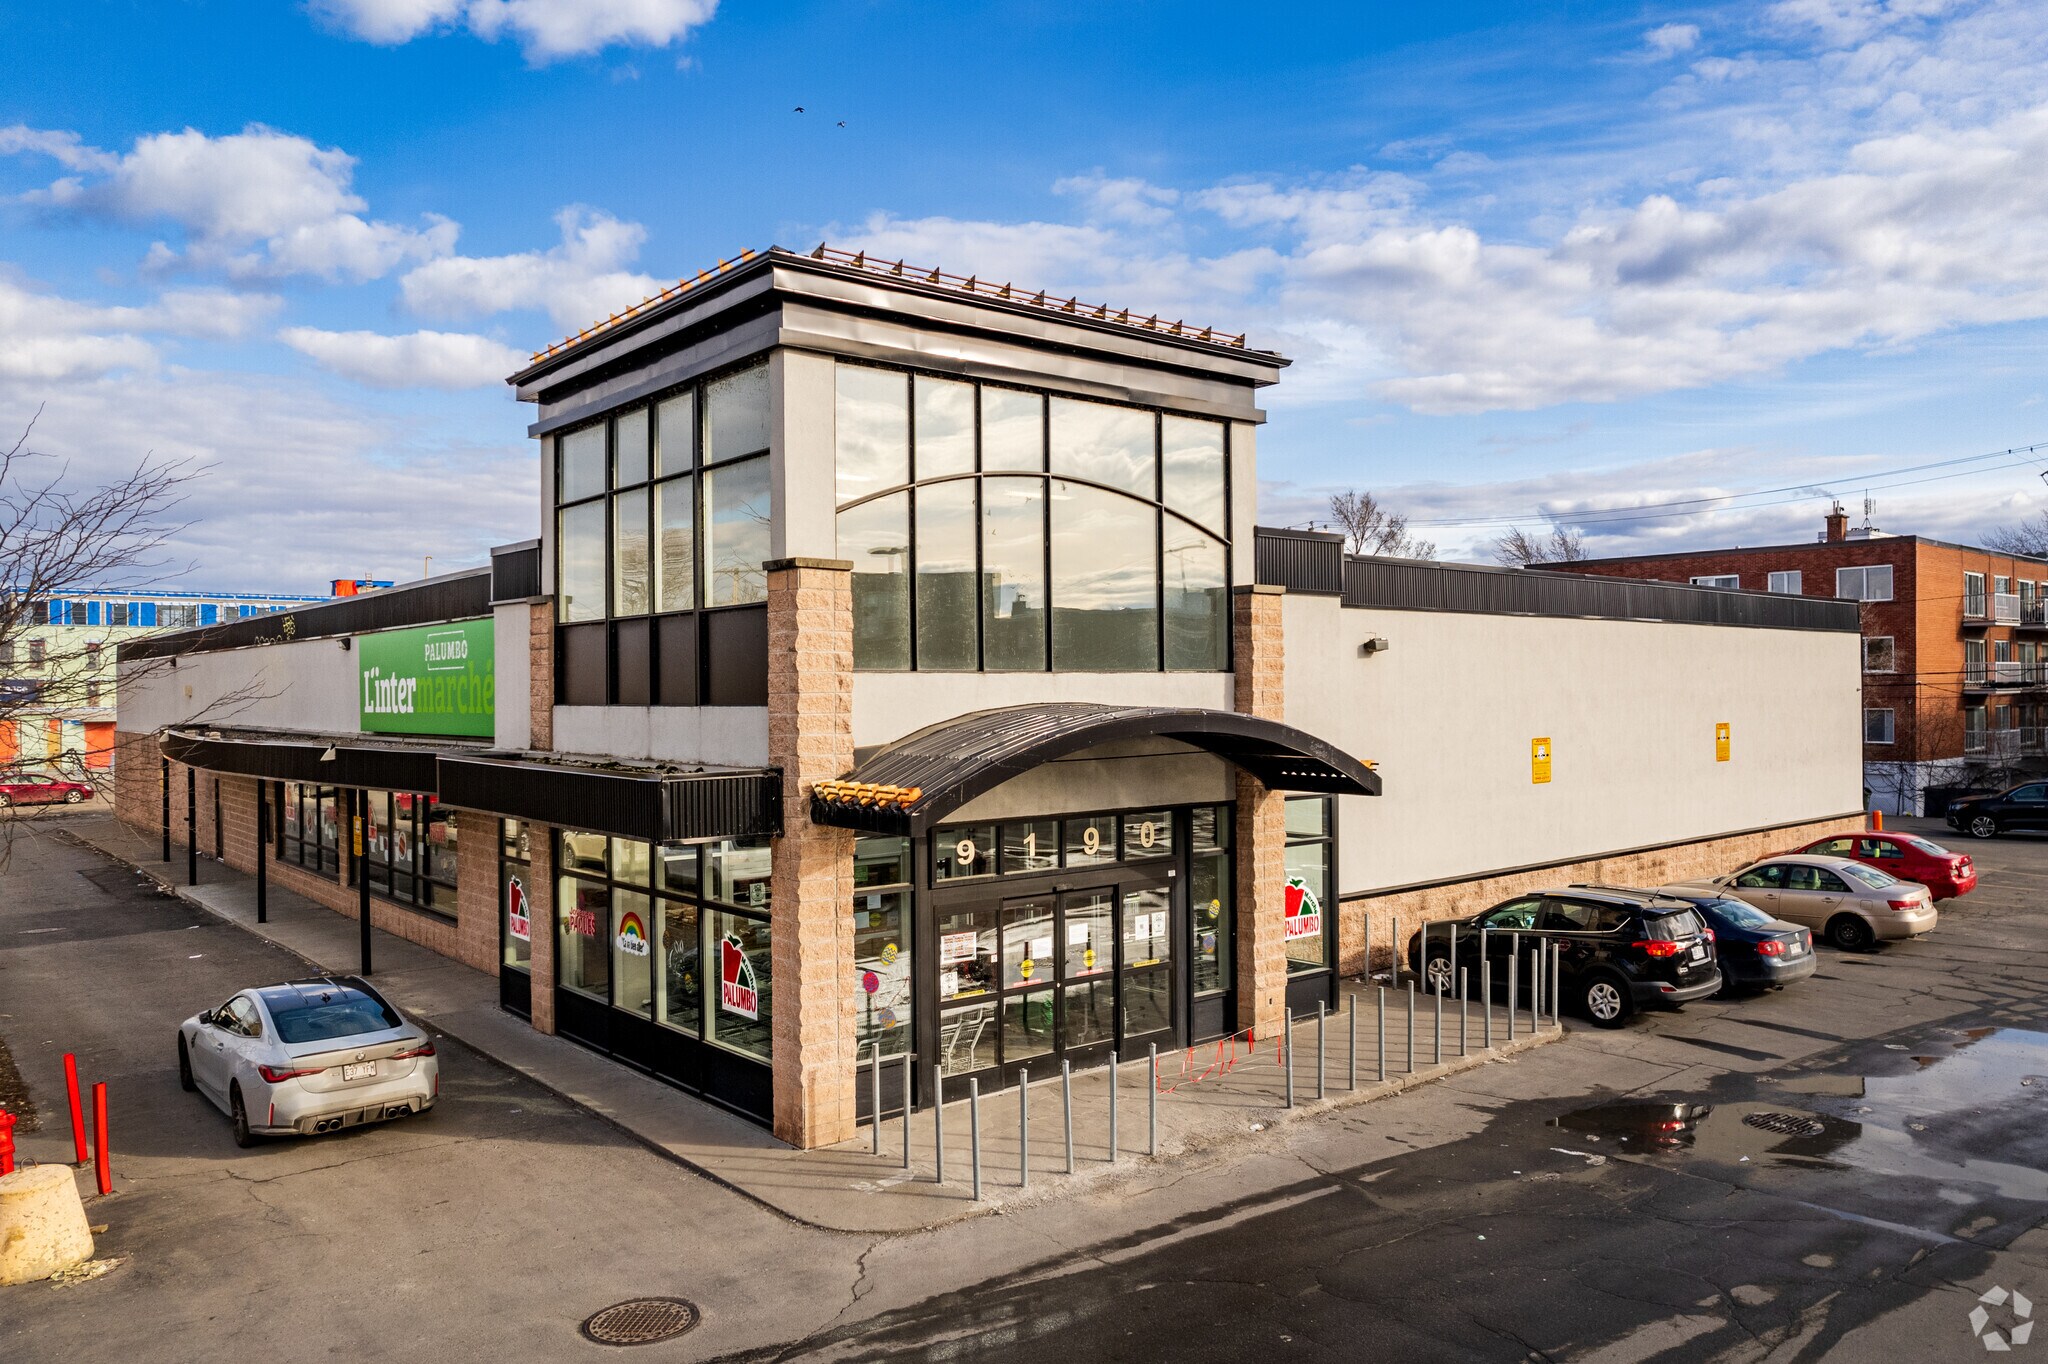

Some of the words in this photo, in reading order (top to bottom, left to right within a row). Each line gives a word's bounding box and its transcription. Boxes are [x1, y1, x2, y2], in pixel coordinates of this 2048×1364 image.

[424, 639, 468, 661] PALUMBO
[510, 915, 530, 938] PALUMBO
[1285, 915, 1319, 937] PALUMBO
[723, 982, 757, 1013] PALUMBO
